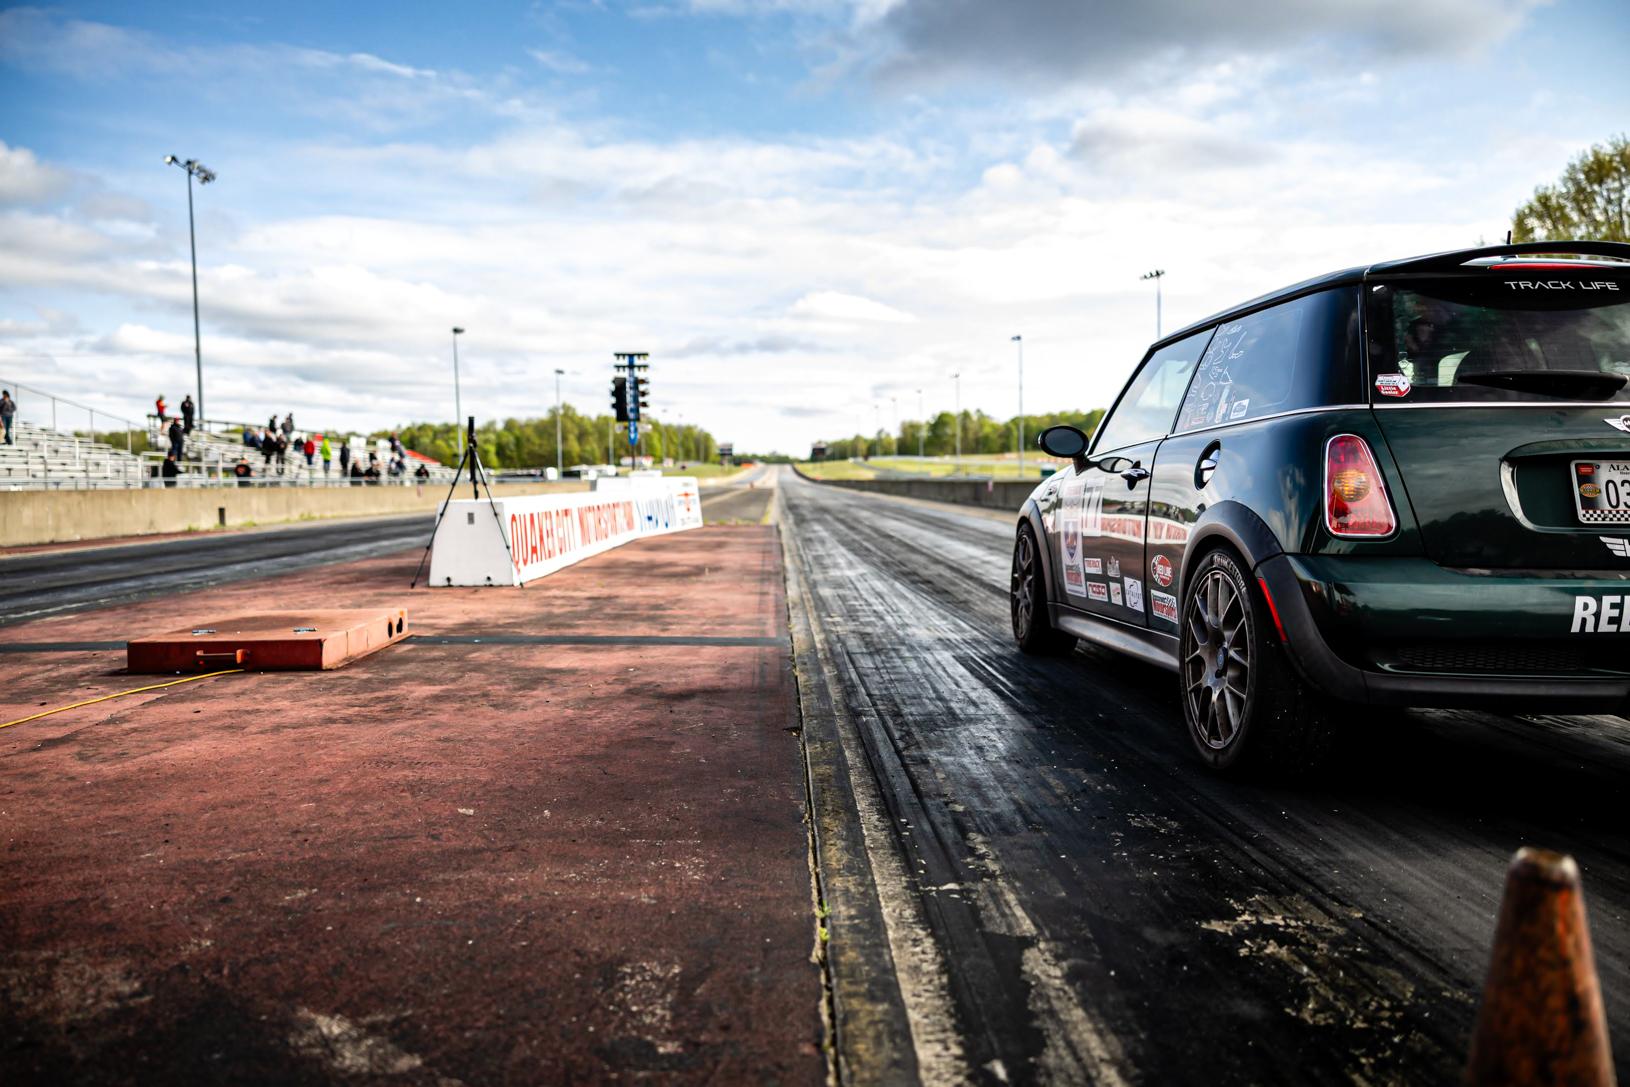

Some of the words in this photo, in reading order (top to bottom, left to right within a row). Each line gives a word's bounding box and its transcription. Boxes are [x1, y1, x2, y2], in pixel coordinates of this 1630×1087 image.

[1504, 281, 1575, 290] TRACK
[1579, 281, 1620, 291] LIFE
[510, 510, 556, 575] QUAKER
